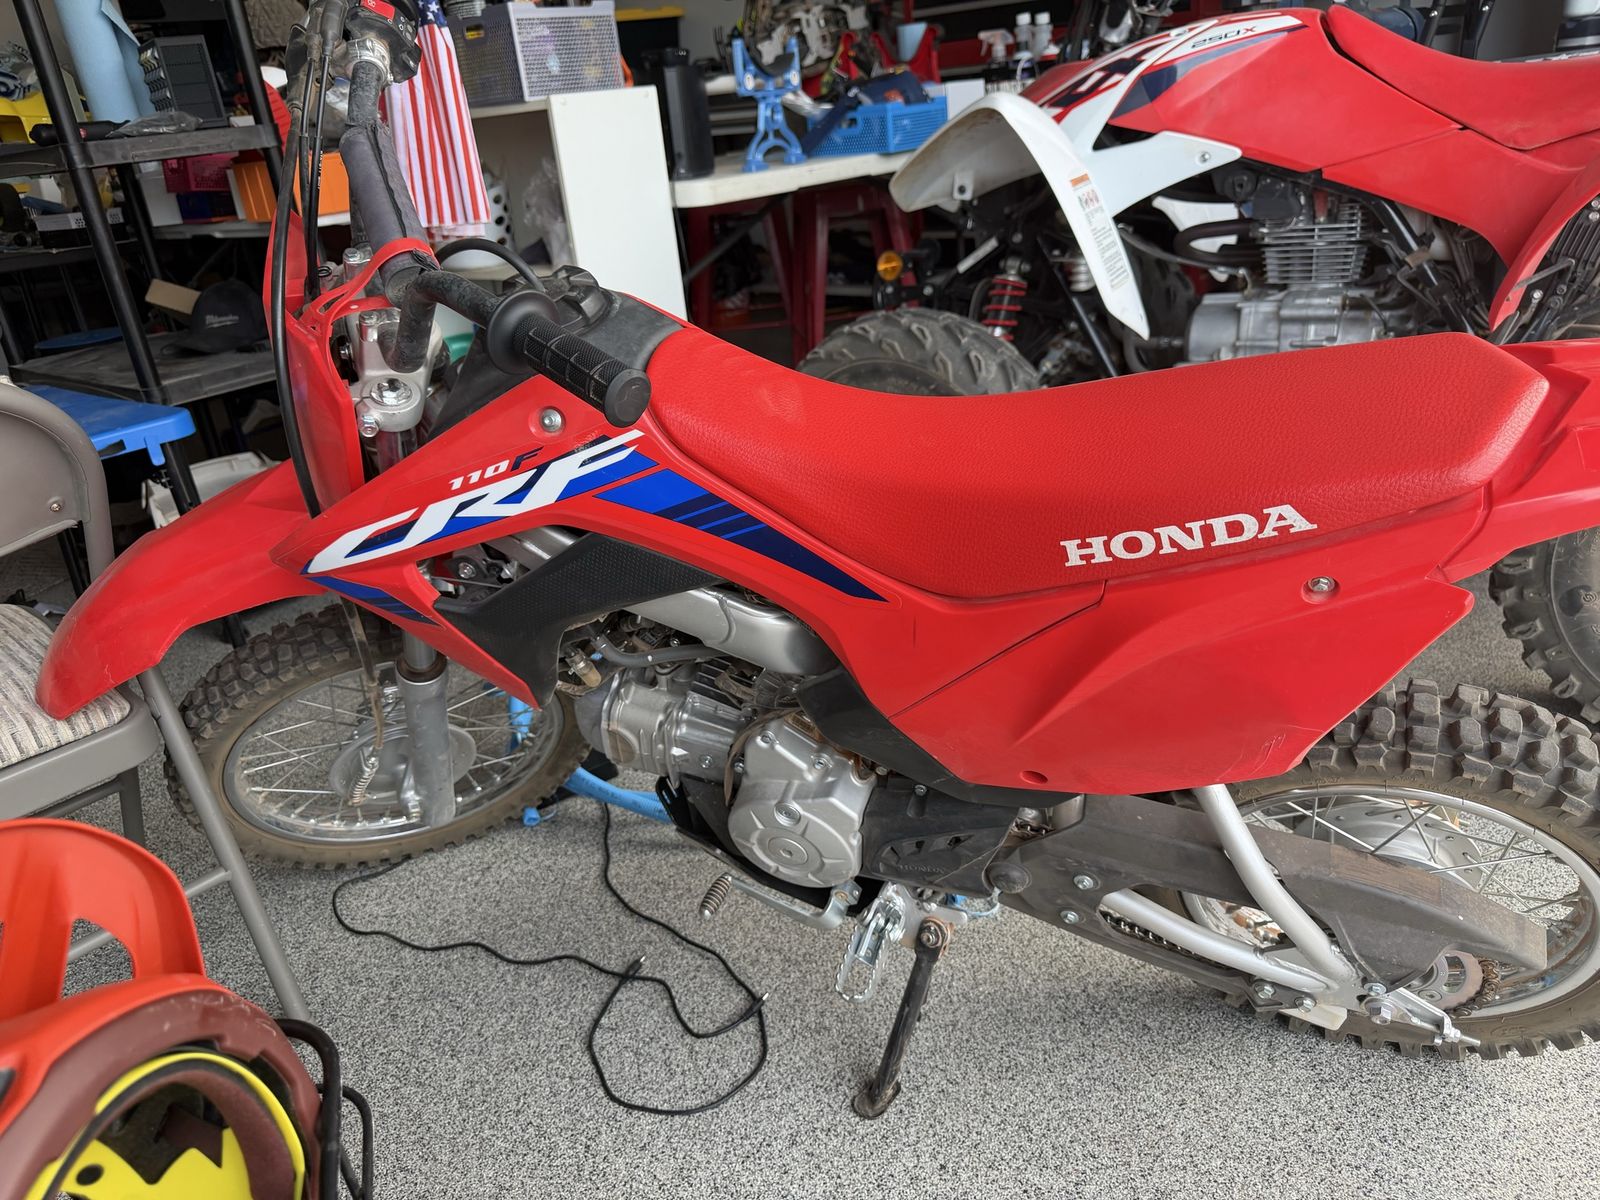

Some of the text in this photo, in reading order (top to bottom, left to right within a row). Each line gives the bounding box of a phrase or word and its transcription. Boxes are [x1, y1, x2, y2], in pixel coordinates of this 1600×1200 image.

[1190, 26, 1257, 48] 250X
[449, 446, 544, 491] 110F
[306, 428, 646, 574] CRF
[1060, 503, 1318, 568] HONDA
